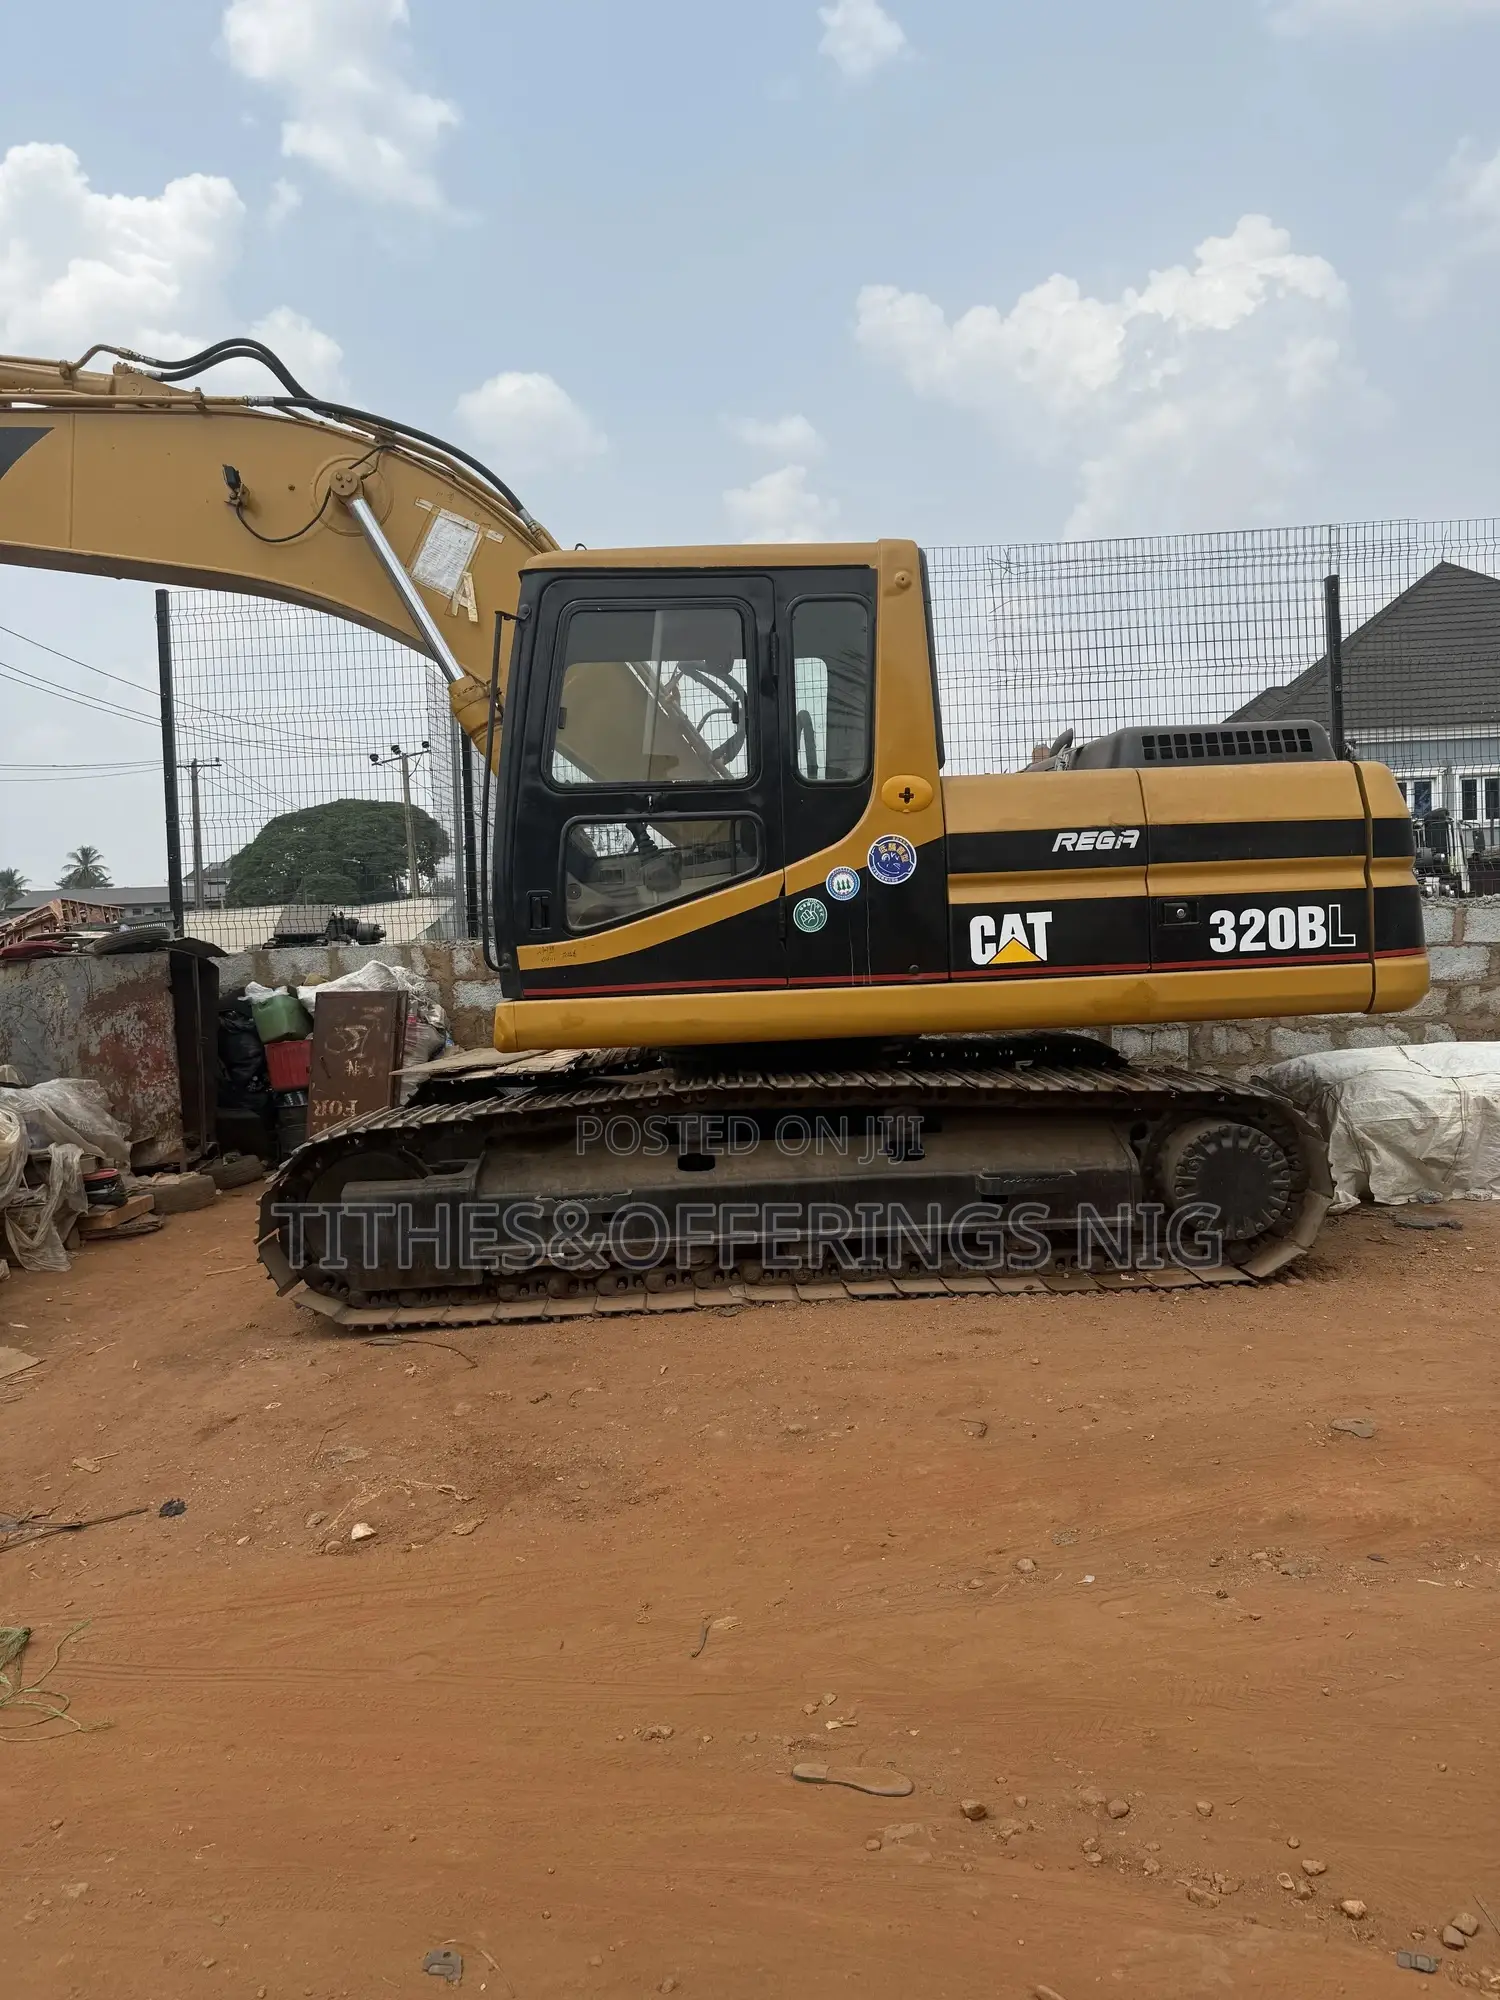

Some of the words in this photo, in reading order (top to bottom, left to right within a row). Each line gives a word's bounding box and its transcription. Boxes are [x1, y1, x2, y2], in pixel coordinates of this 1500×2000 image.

[1052, 829, 1140, 852] REGA
[969, 911, 1053, 965] CAT
[1209, 903, 1357, 953] 320BL
